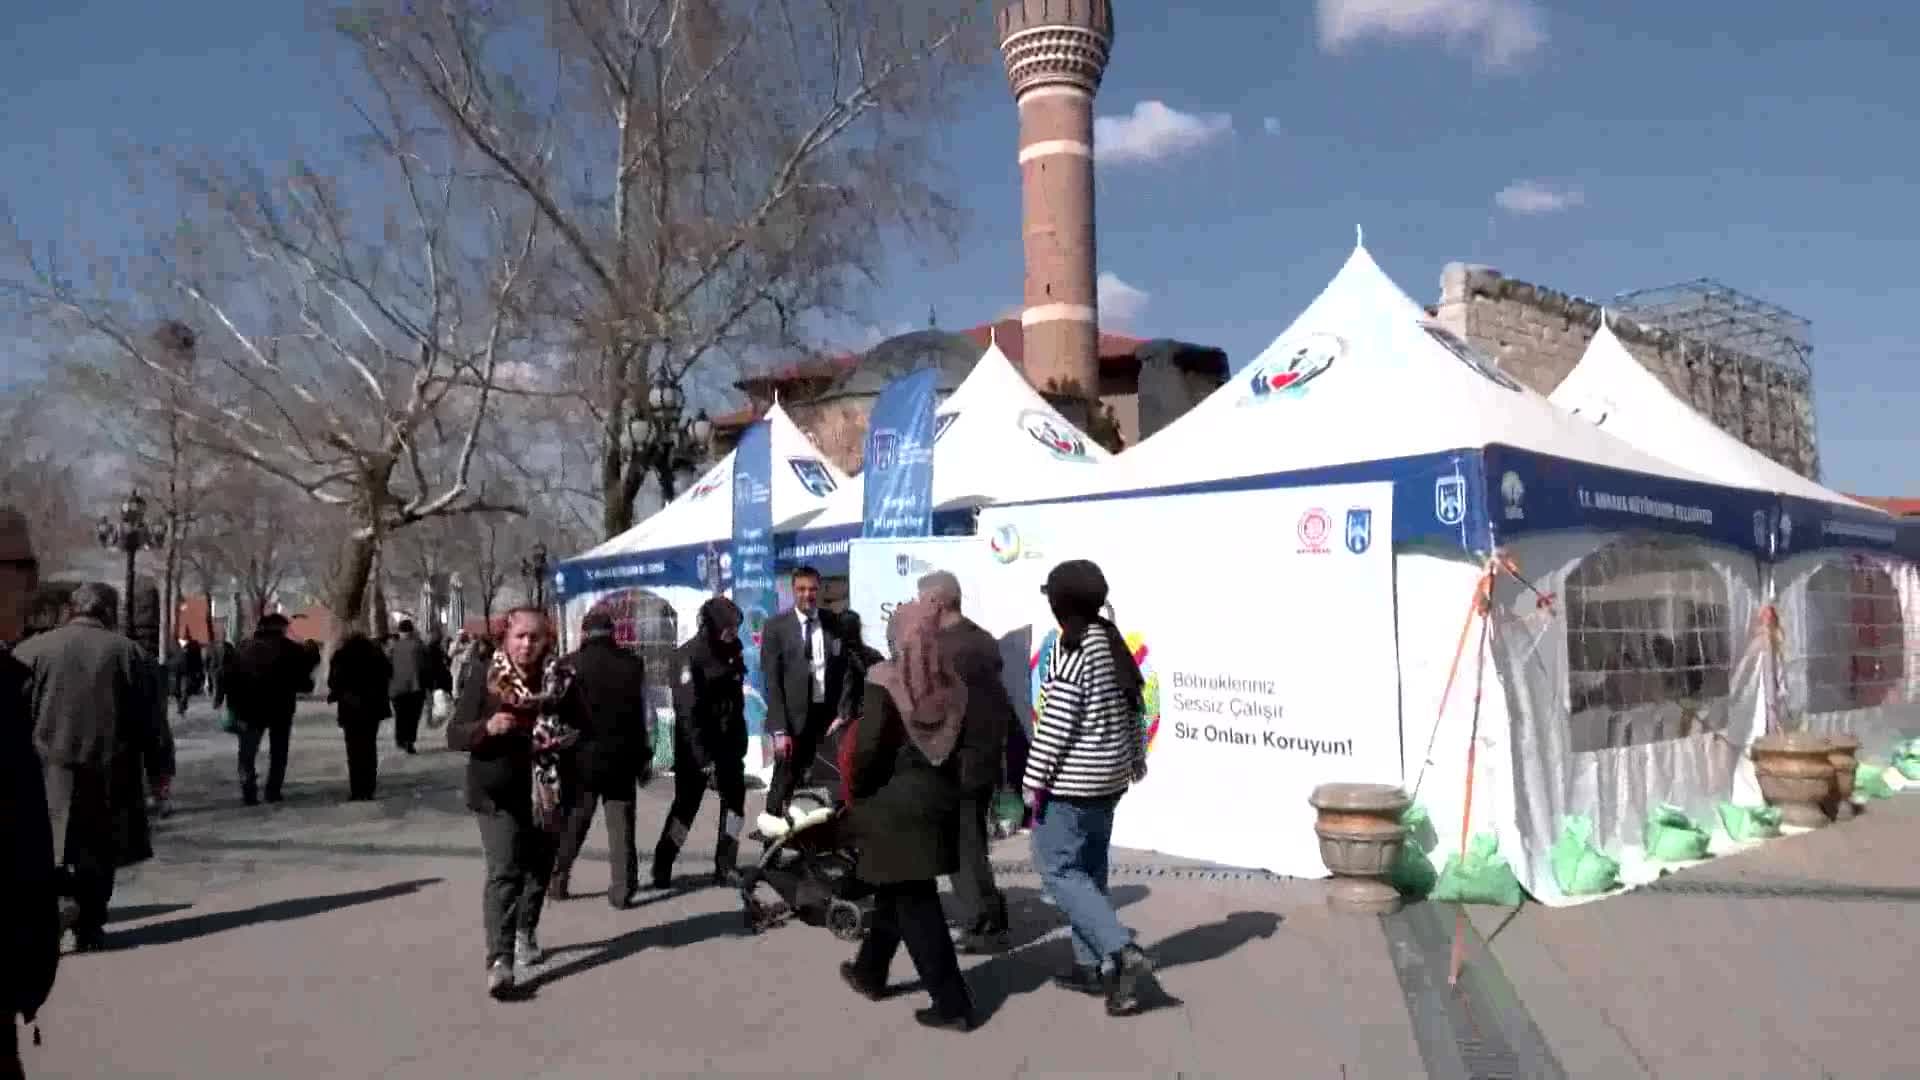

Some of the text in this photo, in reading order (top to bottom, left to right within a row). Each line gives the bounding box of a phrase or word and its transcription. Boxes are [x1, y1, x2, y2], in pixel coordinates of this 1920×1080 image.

[1173, 693, 1224, 714] Sessiz
[1174, 721, 1353, 757] Siz Onları Koruyun!
